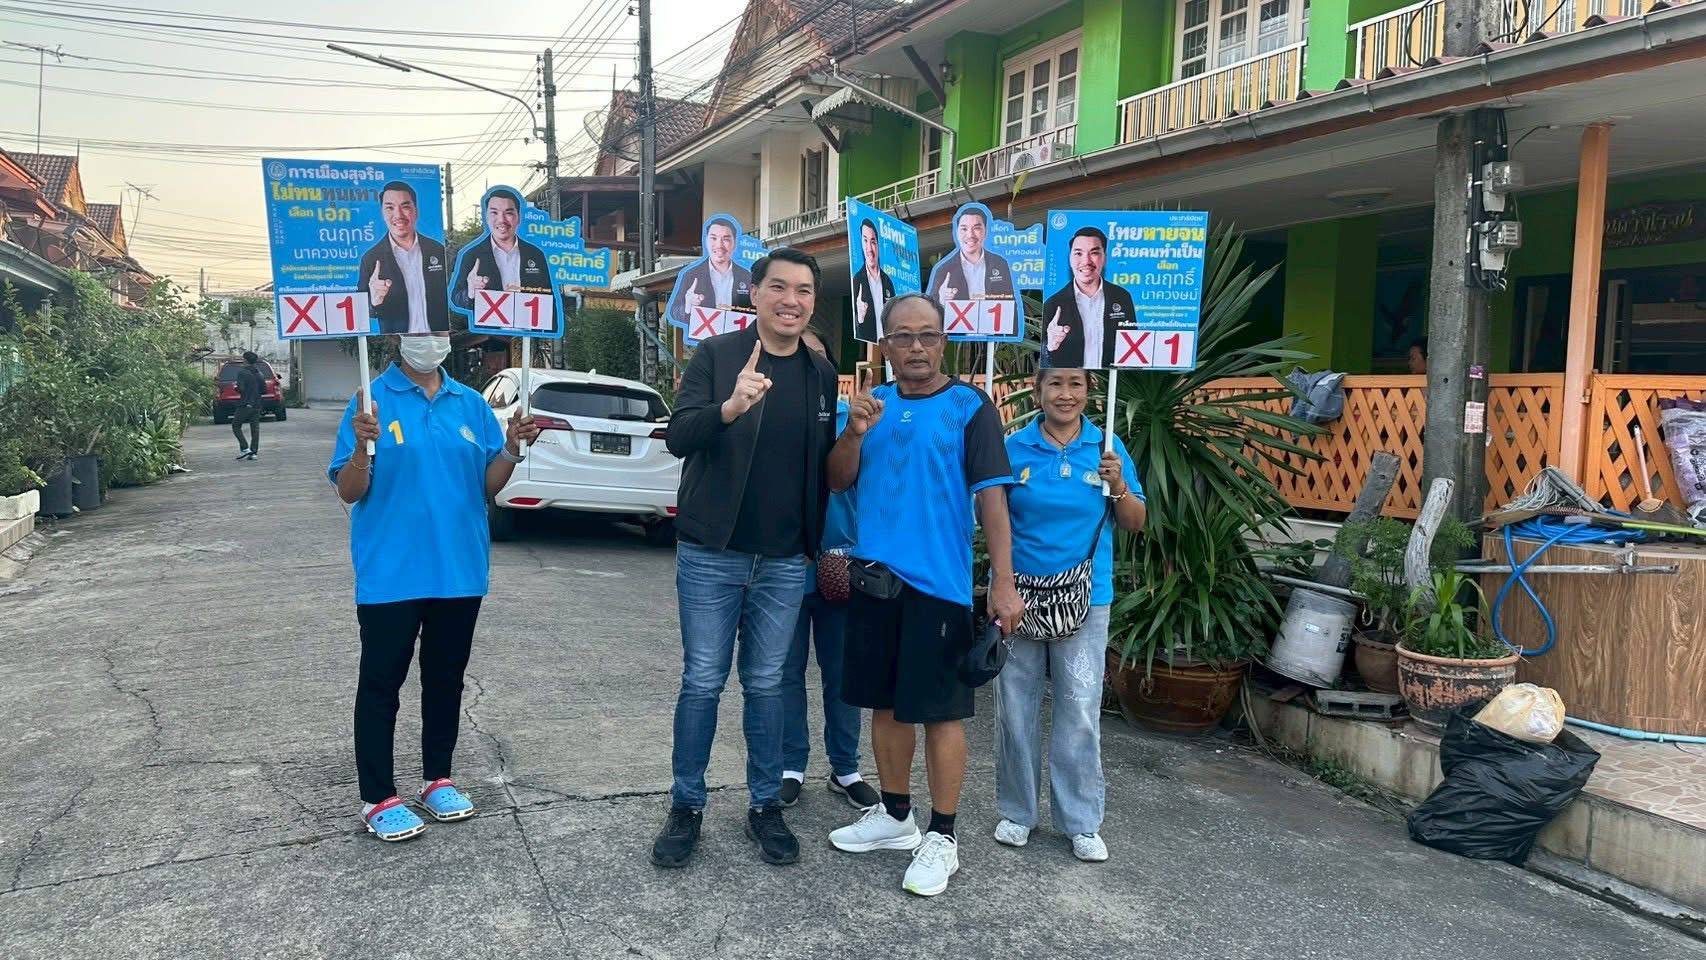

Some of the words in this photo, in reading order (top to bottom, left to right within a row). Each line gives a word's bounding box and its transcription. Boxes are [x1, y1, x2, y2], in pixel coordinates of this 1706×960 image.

[288, 164, 385, 185] การเมืองสุจริต
[288, 205, 314, 218] เลือก
[317, 206, 351, 222] เอก
[524, 210, 545, 222] เลือก
[319, 220, 376, 246] ณฤทธิ์
[528, 221, 577, 239] ณฤทธิ์
[993, 228, 1038, 248] ณฤทธิ์
[1107, 221, 1205, 242] ไทยหายจน
[549, 250, 606, 270] อภิสิทธิ์
[1111, 242, 1203, 260] ด้วยคนทำเป็น
[1011, 258, 1045, 272] อภิสิ
[1157, 259, 1179, 270] เลือก
[555, 268, 605, 284] เป็นนายก
[1017, 274, 1044, 286] เป็นน
[1112, 272, 1140, 286] เอก
[1145, 266, 1196, 289] ณฤทธิ์
[283, 295, 322, 334] X
[335, 295, 355, 331] 1
[477, 291, 511, 325] X
[524, 296, 540, 327] 1
[946, 301, 976, 331] X
[988, 303, 1002, 332] 1
[691, 307, 721, 336] X
[1118, 331, 1151, 365] X
[1164, 333, 1180, 365] 1
[388, 420, 404, 445] 1
